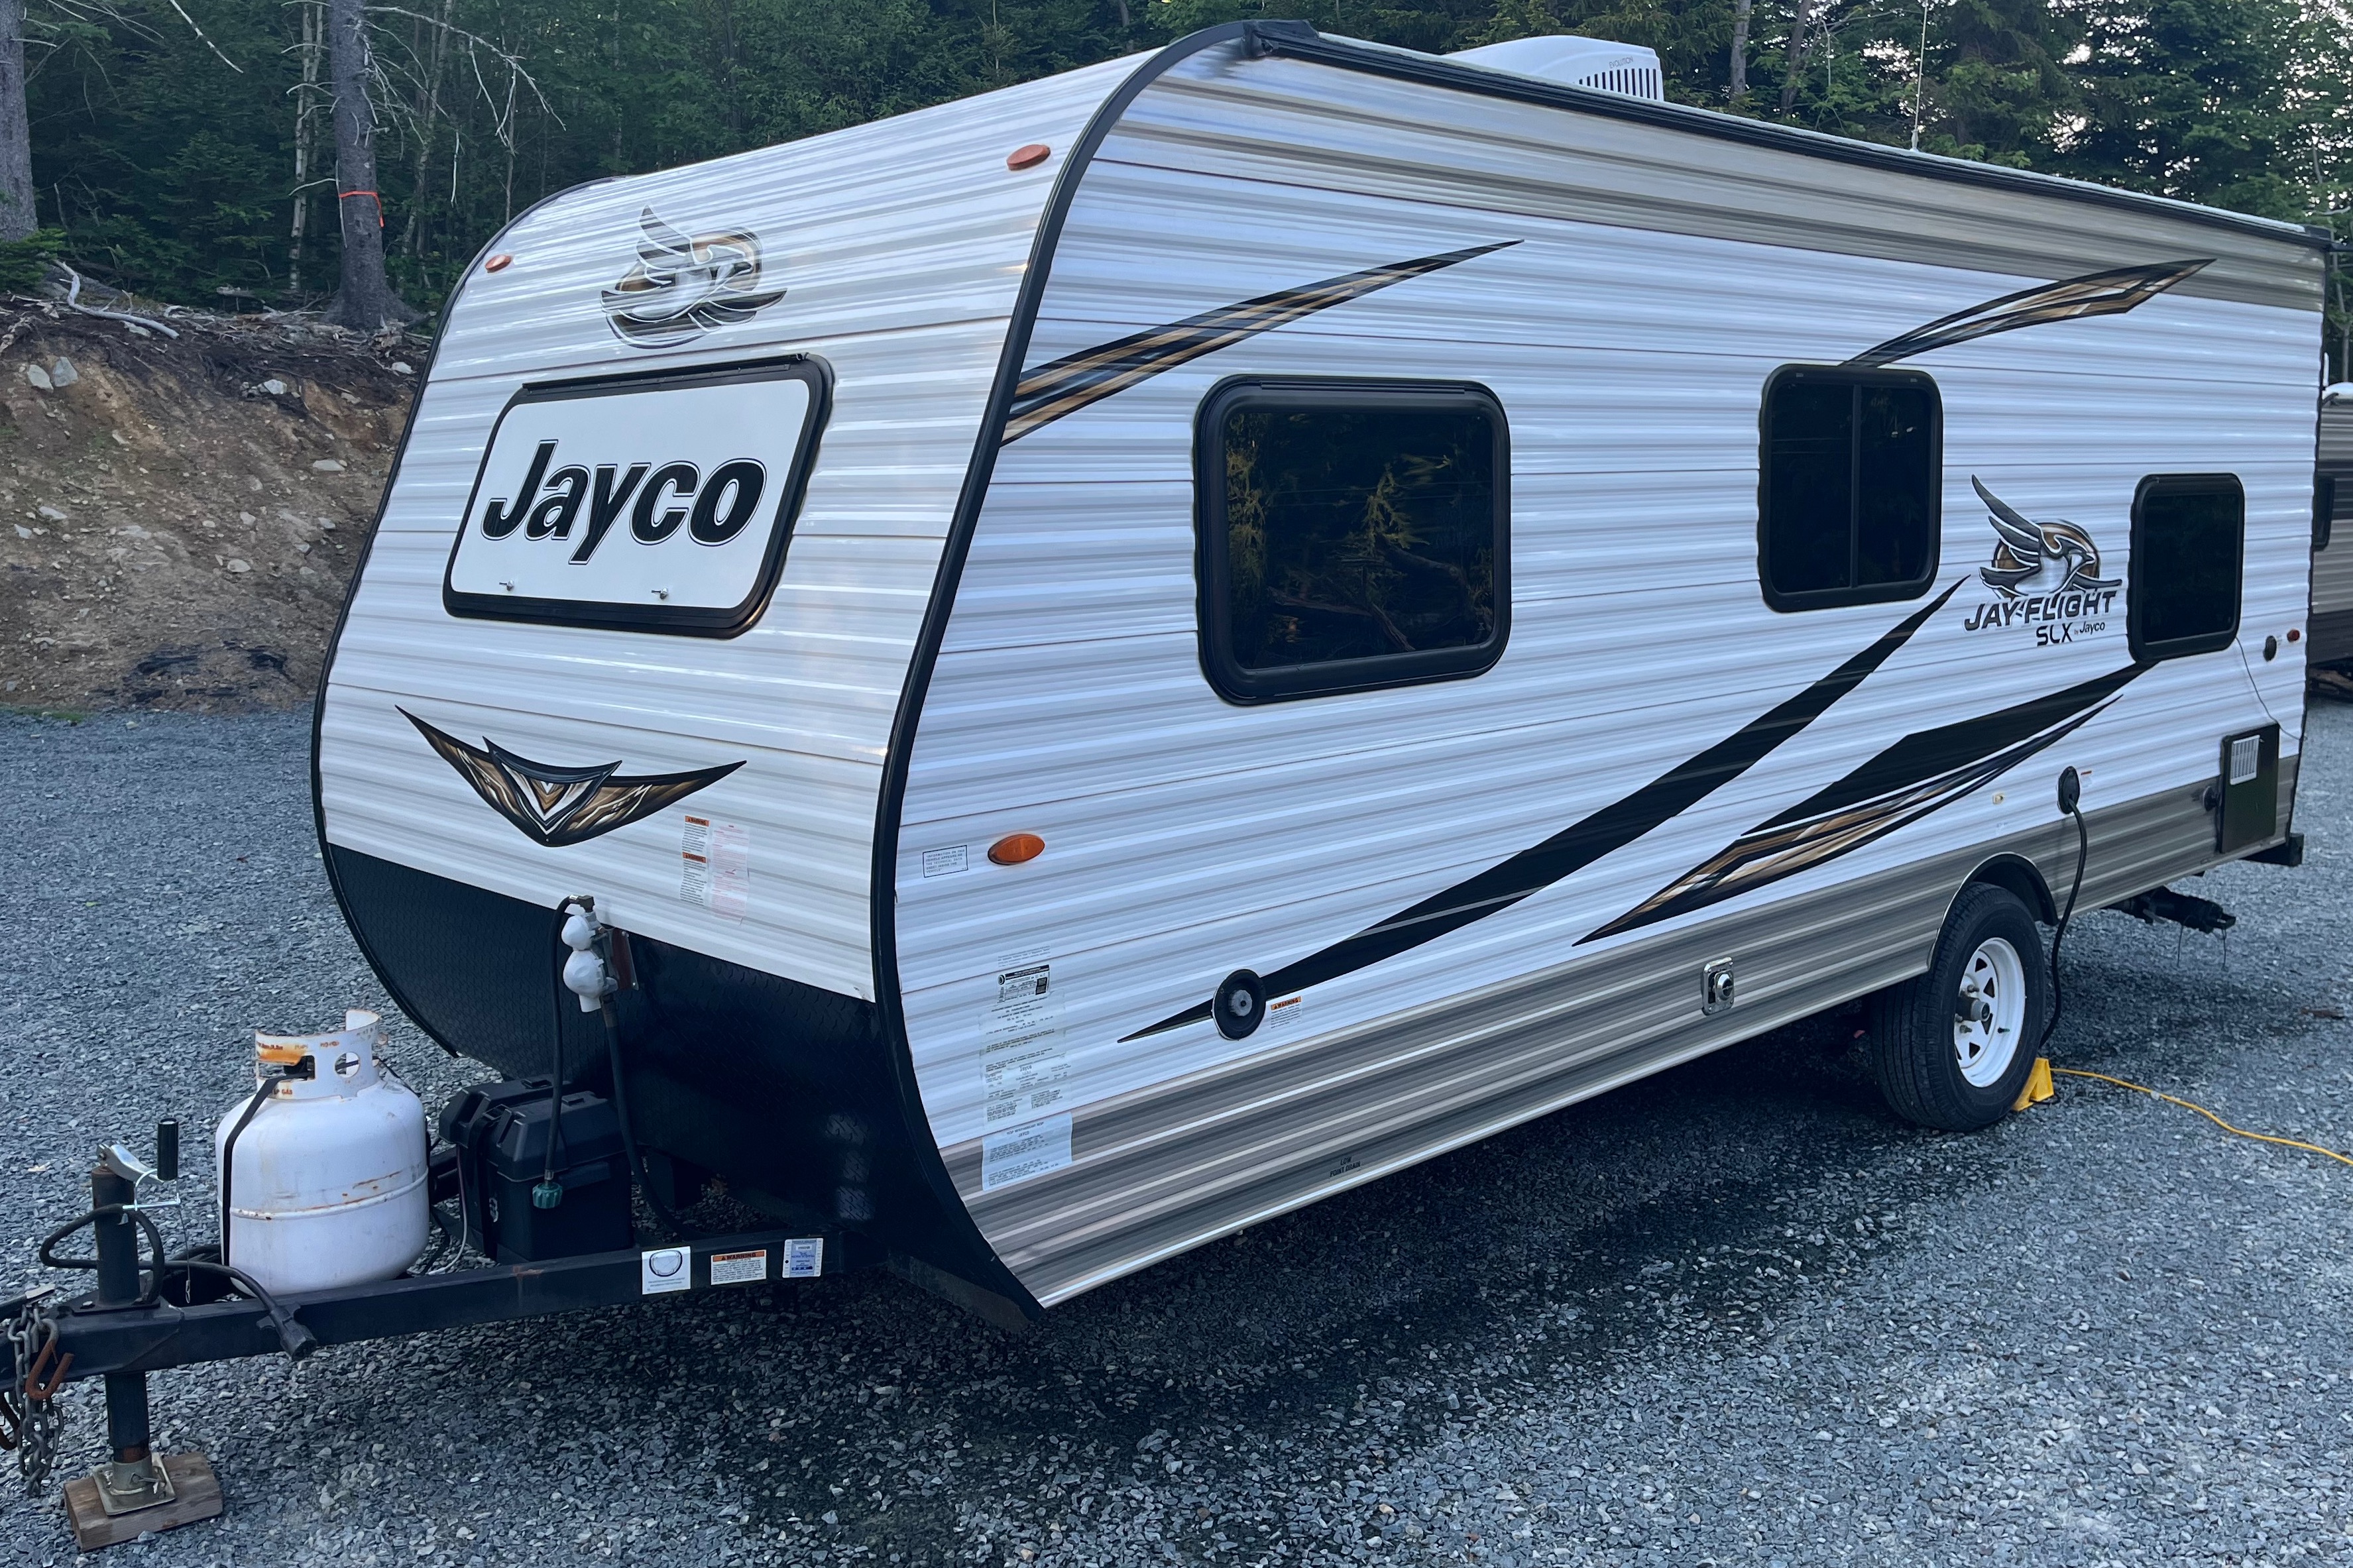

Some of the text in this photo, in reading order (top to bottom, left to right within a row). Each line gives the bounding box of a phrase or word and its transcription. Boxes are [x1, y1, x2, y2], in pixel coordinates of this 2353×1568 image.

[1609, 56, 1634, 69] EVOLUTION
[481, 439, 768, 565] Jayco
[1964, 590, 2118, 631] JAY FLIGHT
[2036, 622, 2074, 647] SLX
[2079, 621, 2106, 636] Jayco
[1330, 1161, 1361, 1177] POINT DRAIN
[1340, 1156, 1351, 1166] LOW
[726, 1252, 756, 1260] WARNING
